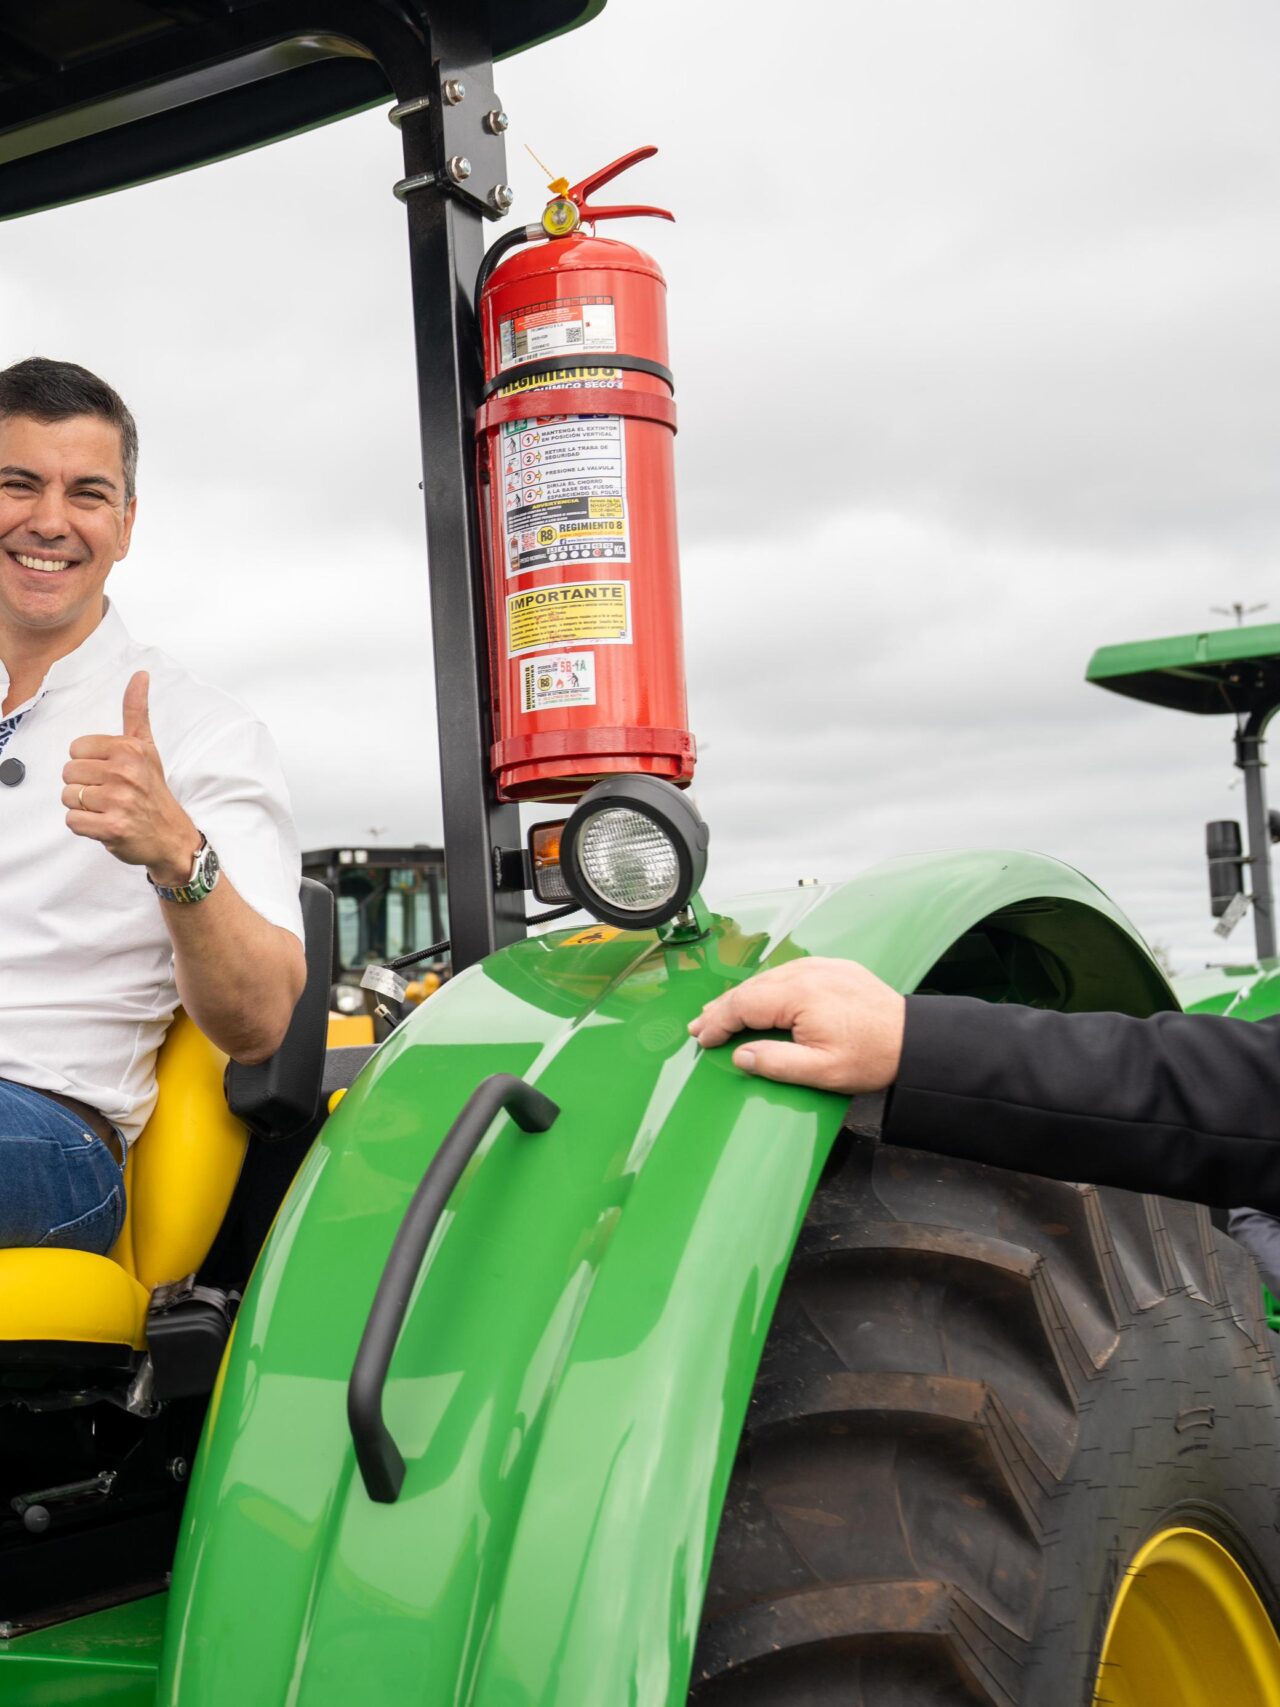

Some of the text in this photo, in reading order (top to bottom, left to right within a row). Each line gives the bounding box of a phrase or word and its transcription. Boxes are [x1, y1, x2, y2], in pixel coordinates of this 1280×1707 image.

[542, 427, 575, 436] MANTENGA
[544, 452, 580, 460] SEGURIDAD
[559, 520, 622, 533] REGIMIENTO 8
[540, 529, 554, 542] R8
[510, 587, 622, 612] IMPORTANTE
